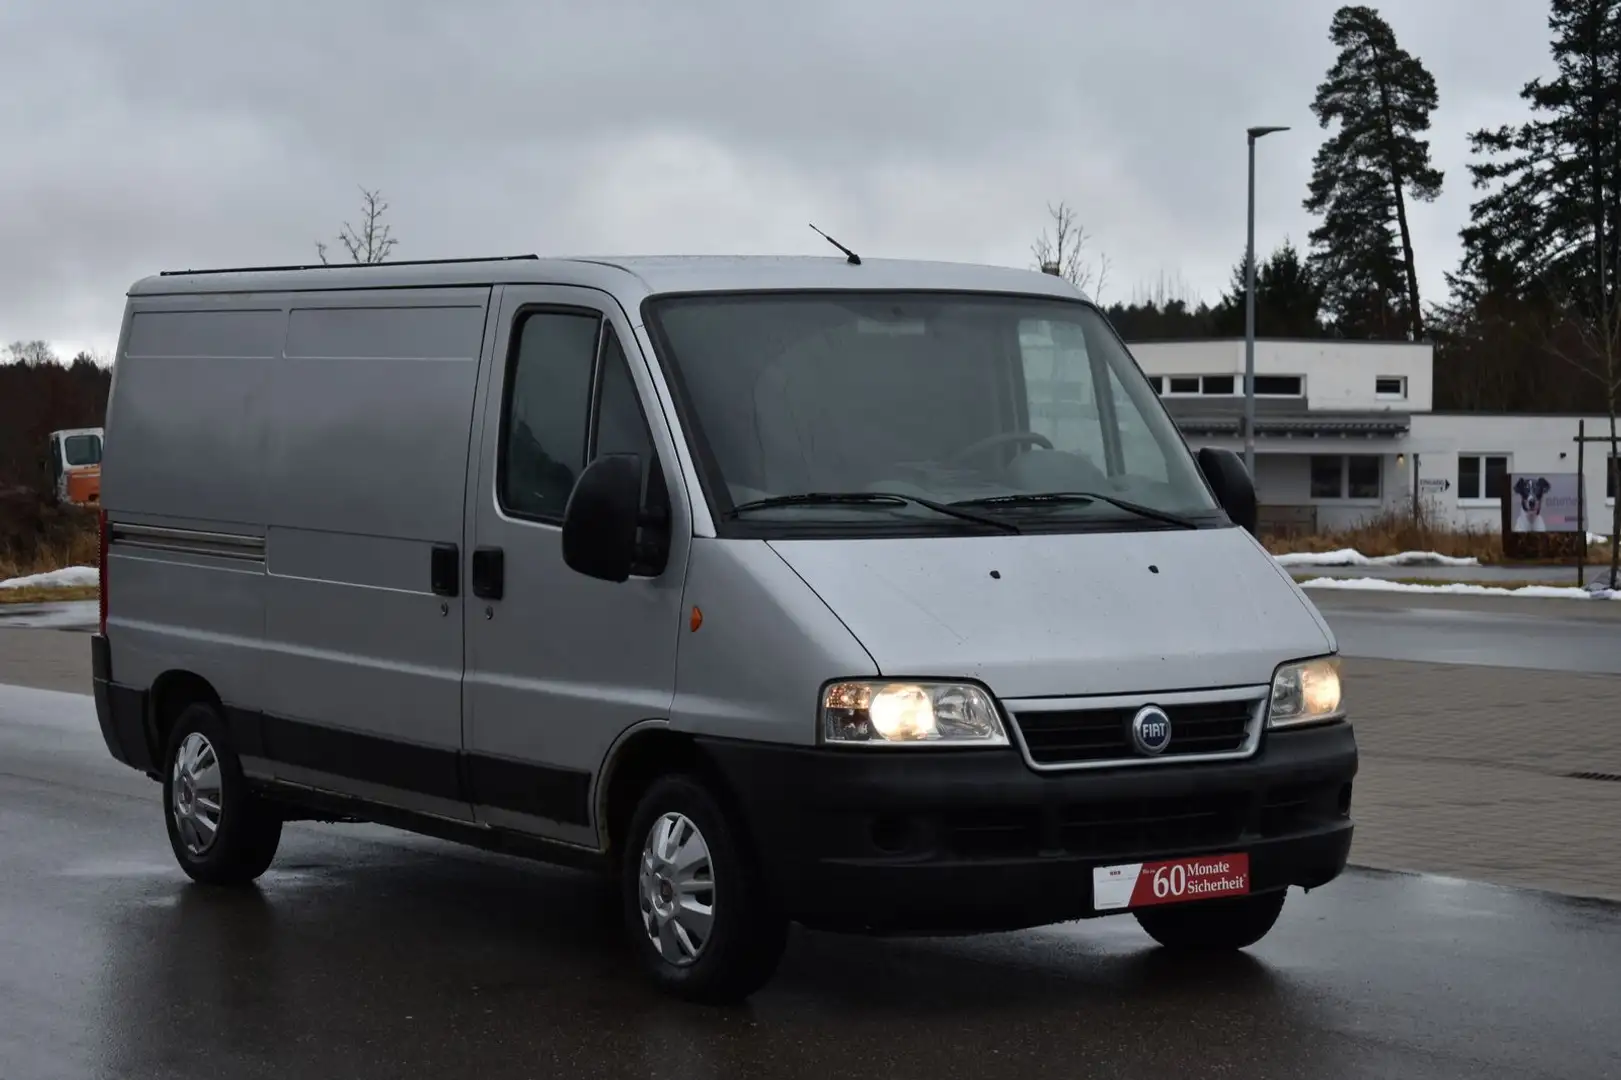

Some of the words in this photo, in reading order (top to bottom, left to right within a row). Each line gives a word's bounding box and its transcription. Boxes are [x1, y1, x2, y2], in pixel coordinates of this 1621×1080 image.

[1142, 723, 1165, 738] FIAT
[1187, 862, 1230, 876] Monate
[1153, 865, 1186, 897] 60
[1187, 877, 1245, 894] Sicherheit
